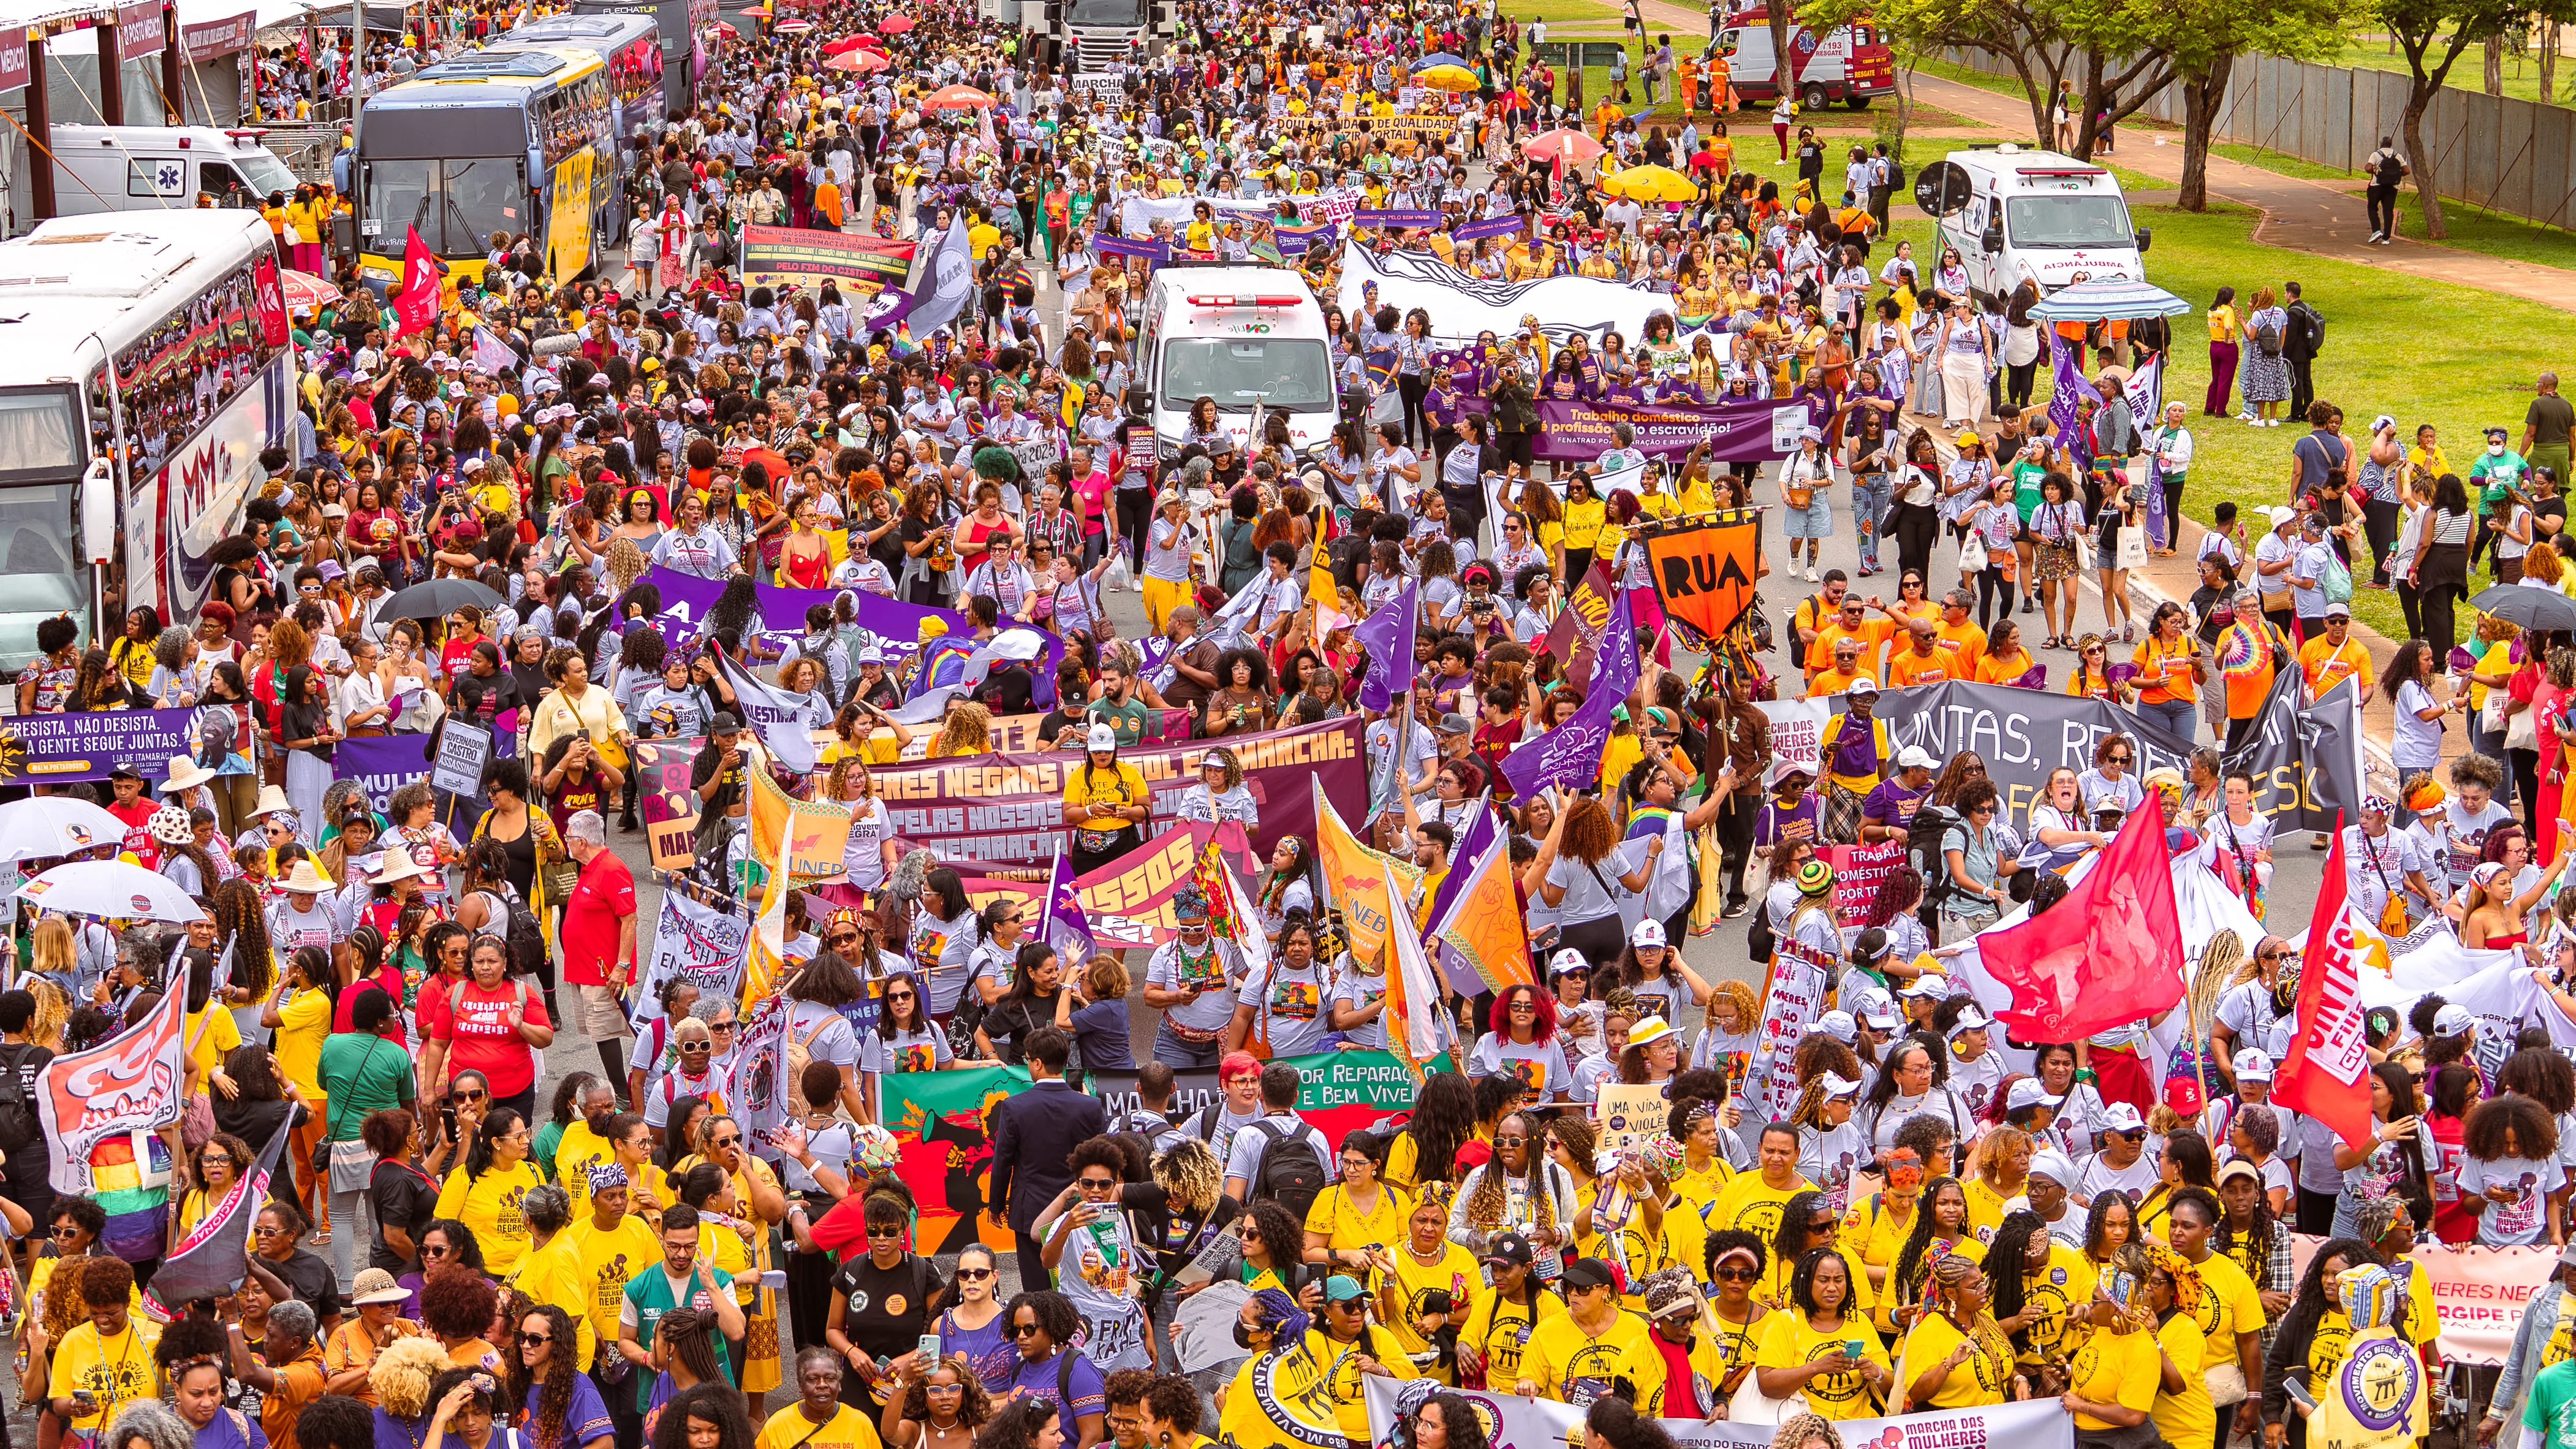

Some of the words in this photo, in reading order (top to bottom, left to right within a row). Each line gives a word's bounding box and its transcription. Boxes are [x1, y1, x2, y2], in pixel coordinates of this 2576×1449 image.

[604, 6, 658, 15] FLECHATUR
[129, 21, 145, 43] POSTO
[145, 13, 162, 42] MÉDICO
[1, 46, 25, 74] MÉDICO
[1855, 69, 1875, 78] RESGATE
[1073, 79, 1123, 88] MARCHA
[1377, 119, 1390, 128] DE
[1393, 118, 1454, 129] QUALIDADE
[795, 238, 844, 248] SUPREMACIA
[847, 243, 877, 253] BRANCA
[776, 262, 799, 271] PELO
[801, 263, 820, 272] FIM
[822, 265, 836, 273] DO
[838, 267, 879, 281] CISTEMA
[1570, 409, 1629, 422] Trabalho
[1632, 412, 1700, 422] doméstico
[1541, 422, 1547, 432] é
[1551, 422, 1612, 436] profissão
[1649, 423, 1730, 435] escravidão!
[1661, 552, 1751, 599] RUA
[1567, 601, 1588, 636] JUVENTUDE
[9, 722, 70, 737] "RESISTA,
[75, 716, 99, 734] NÃO
[105, 715, 161, 732] DESISTA.
[1794, 720, 1814, 731] DAS
[27, 740, 34, 755] A
[39, 738, 79, 754] GENTE
[84, 735, 124, 751] SEGUE
[445, 731, 484, 751] GOVERNADOR
[1236, 729, 1355, 770] MARCHA:
[113, 754, 123, 763] LIA
[125, 754, 134, 763] DE
[135, 750, 174, 762] ITAMARACÁ
[447, 742, 477, 761] CASTRO
[439, 755, 479, 777] ASSASSINO!
[945, 763, 1059, 798] NEGRAS
[889, 807, 964, 834] PELAS
[969, 801, 1063, 831] NOSSAS
[1779, 818, 1813, 831] Trabalho
[930, 826, 1069, 864] REPARAÇÃO
[986, 868, 1040, 881] BRASÍLIA
[1839, 889, 1864, 901] POR
[678, 964, 727, 992] MARCHA
[1334, 1065, 1438, 1084] REPARAÇO
[1105, 1089, 1211, 1116] MACHA
[1303, 1090, 1313, 1105] E
[1323, 1087, 1358, 1105] BEM
[1778, 1090, 1784, 1099] E
[1608, 1101, 1629, 1115] UMA
[1637, 1099, 1662, 1112] VIDA
[1604, 1137, 1613, 1147] É
[193, 1189, 240, 1244] NACIONAL
[2496, 1218, 2537, 1227] MULHERES
[1196, 1250, 1216, 1268] CHEGA
[1213, 1234, 1229, 1252] MAIS!
[599, 1297, 622, 1306] NEGR
[2437, 1306, 2490, 1322] RGIPE
[2352, 1350, 2373, 1411] MOVIMENTO
[2374, 1345, 2399, 1360] NEGRO
[1254, 1352, 1324, 1446] MOVIMENTO
[1906, 1422, 1960, 1436] MARCHA
[1963, 1417, 1985, 1431] DAS
[1714, 1439, 1730, 1448] DO
[1909, 1431, 1987, 1449] MULHERES
